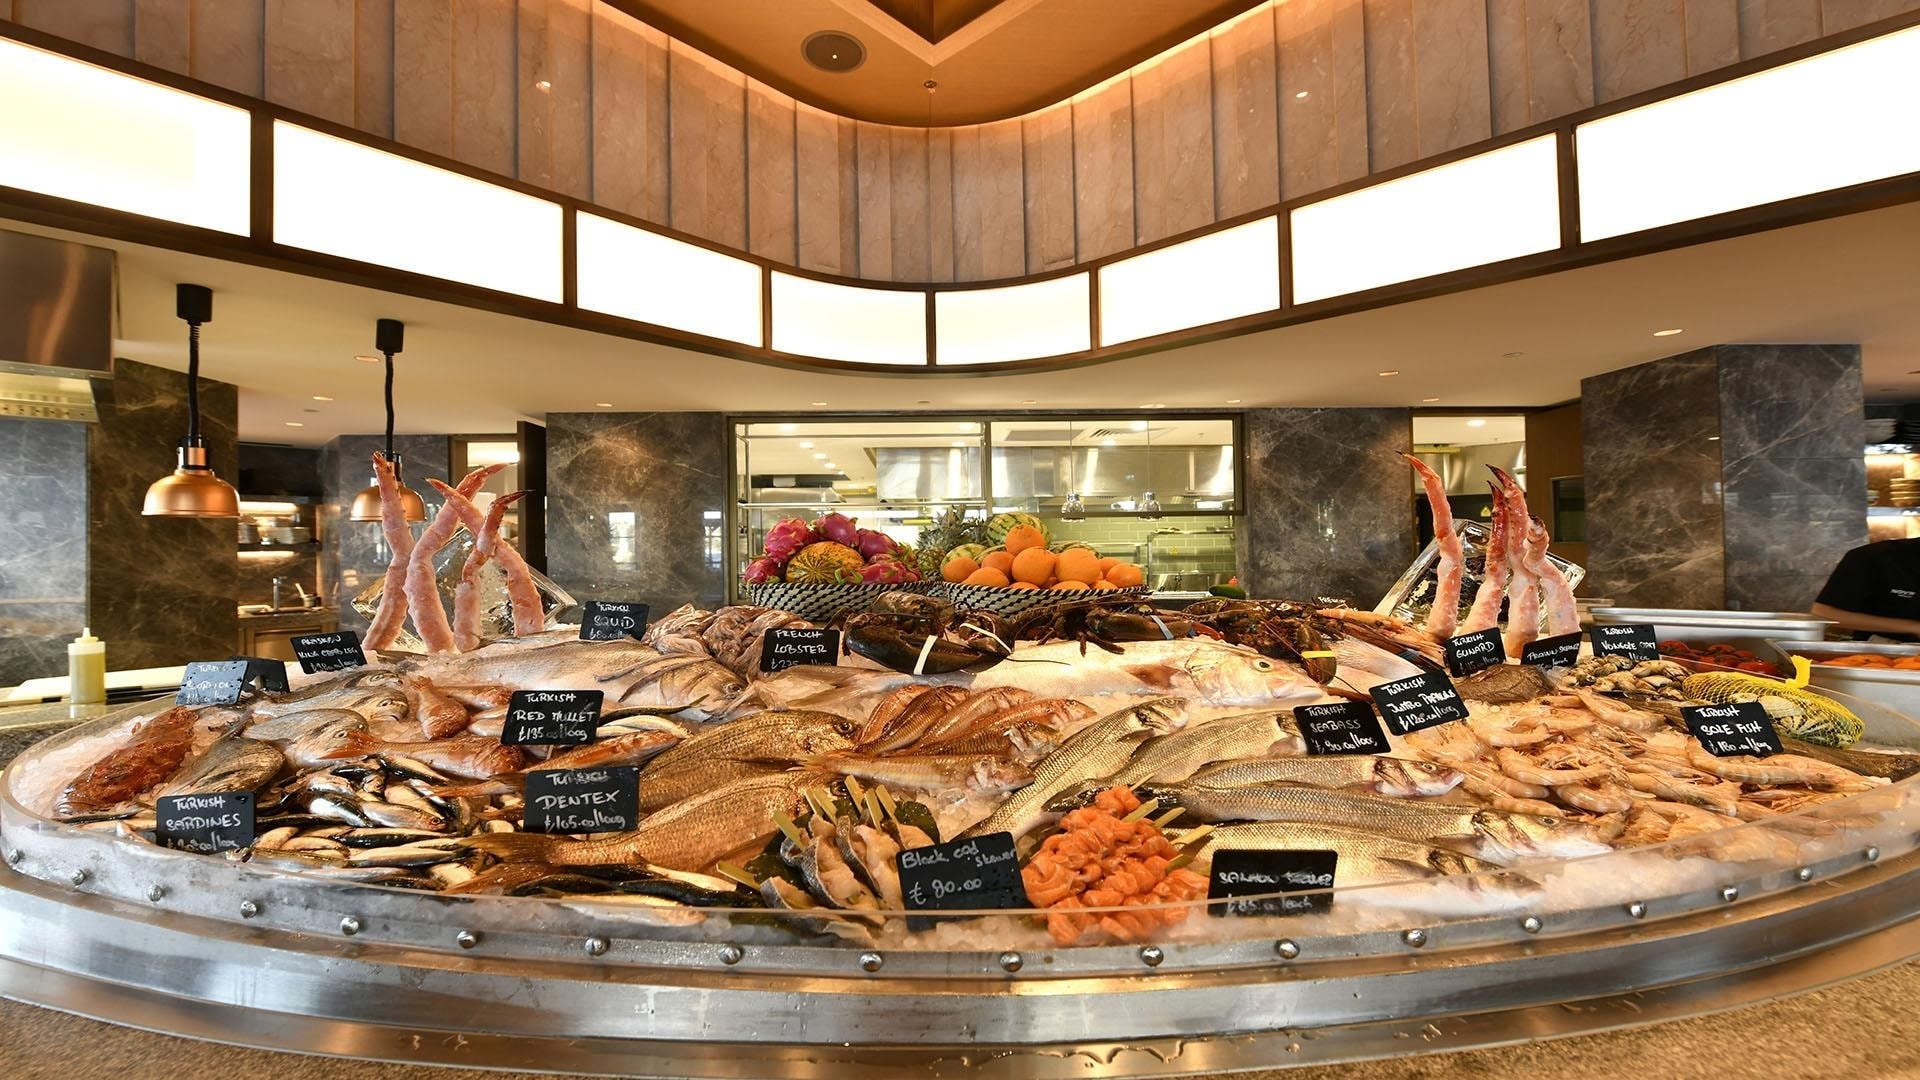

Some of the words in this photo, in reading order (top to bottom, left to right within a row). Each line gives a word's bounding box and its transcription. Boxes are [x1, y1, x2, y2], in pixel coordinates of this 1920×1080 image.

[775, 629, 824, 639] FRENCH
[774, 643, 828, 655] LOBSTER
[1381, 677, 1426, 696] TURKISH
[525, 692, 577, 703] TURKISH
[513, 709, 546, 721] RED
[552, 710, 597, 722] MULLET
[1305, 704, 1346, 717] TURKISH
[1695, 705, 1740, 718] TURKISH
[1309, 719, 1361, 733] SEABASS
[1700, 723, 1734, 736] SOLE
[1736, 720, 1763, 734] FISH
[172, 796, 226, 811] TURKISH
[535, 789, 620, 810] DENTEX
[166, 813, 241, 832] SARDINES
